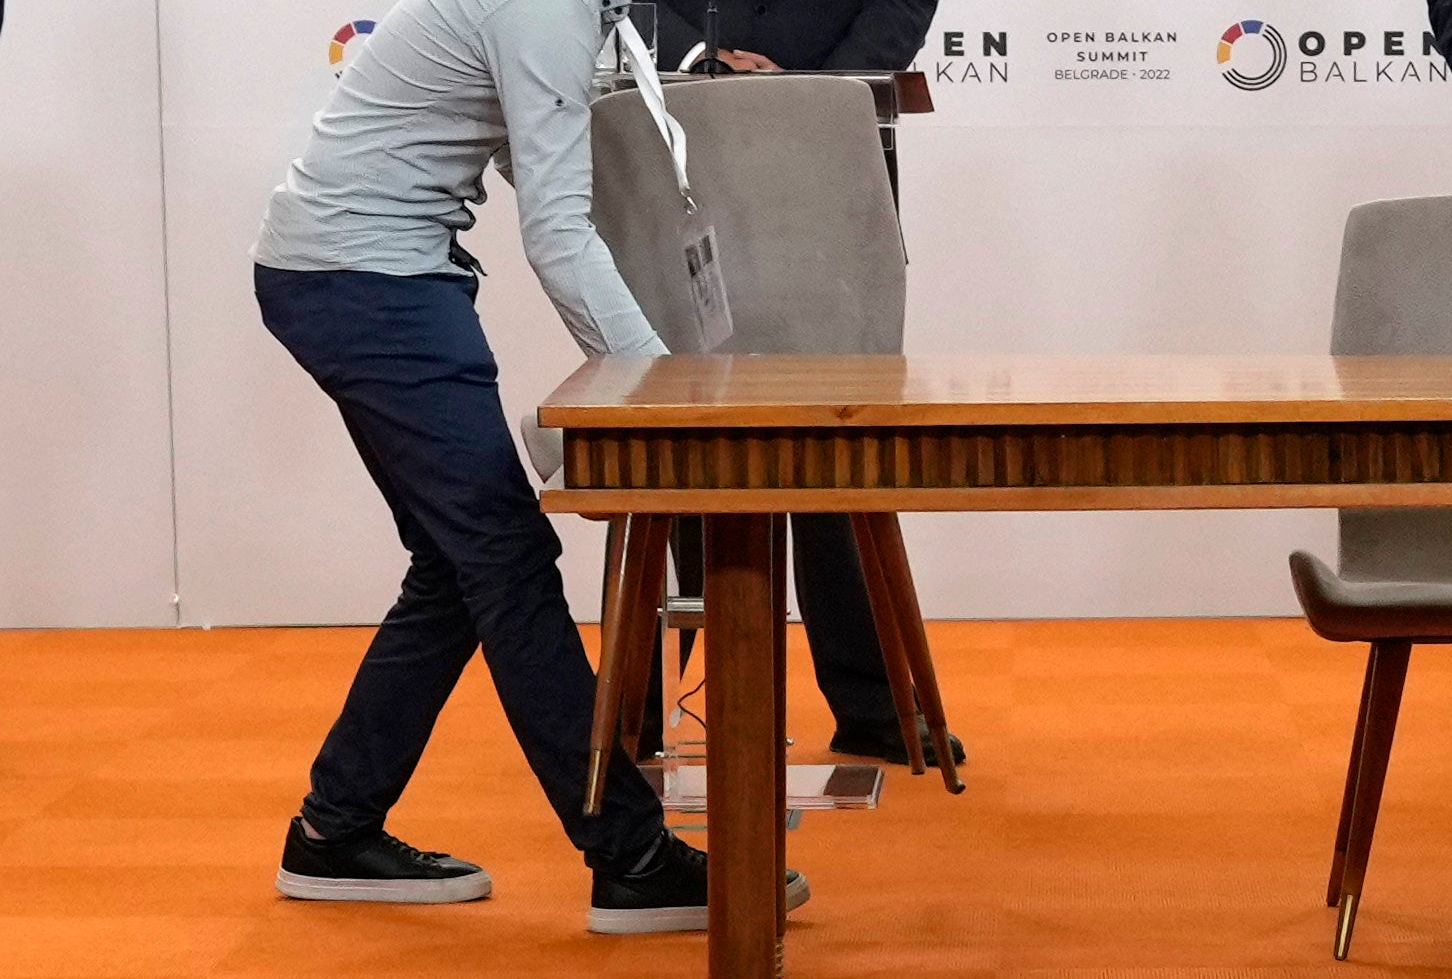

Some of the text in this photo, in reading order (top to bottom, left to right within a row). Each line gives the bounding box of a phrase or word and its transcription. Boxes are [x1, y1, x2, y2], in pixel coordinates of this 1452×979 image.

[943, 31, 1007, 57] EN
[1046, 31, 1177, 43] OPEN BALKAN
[1076, 51, 1148, 63] SUMMIT
[913, 61, 1008, 83] KAN
[1054, 68, 1171, 80] BELGRADE 2022
[1300, 61, 1448, 83] BALKAN
